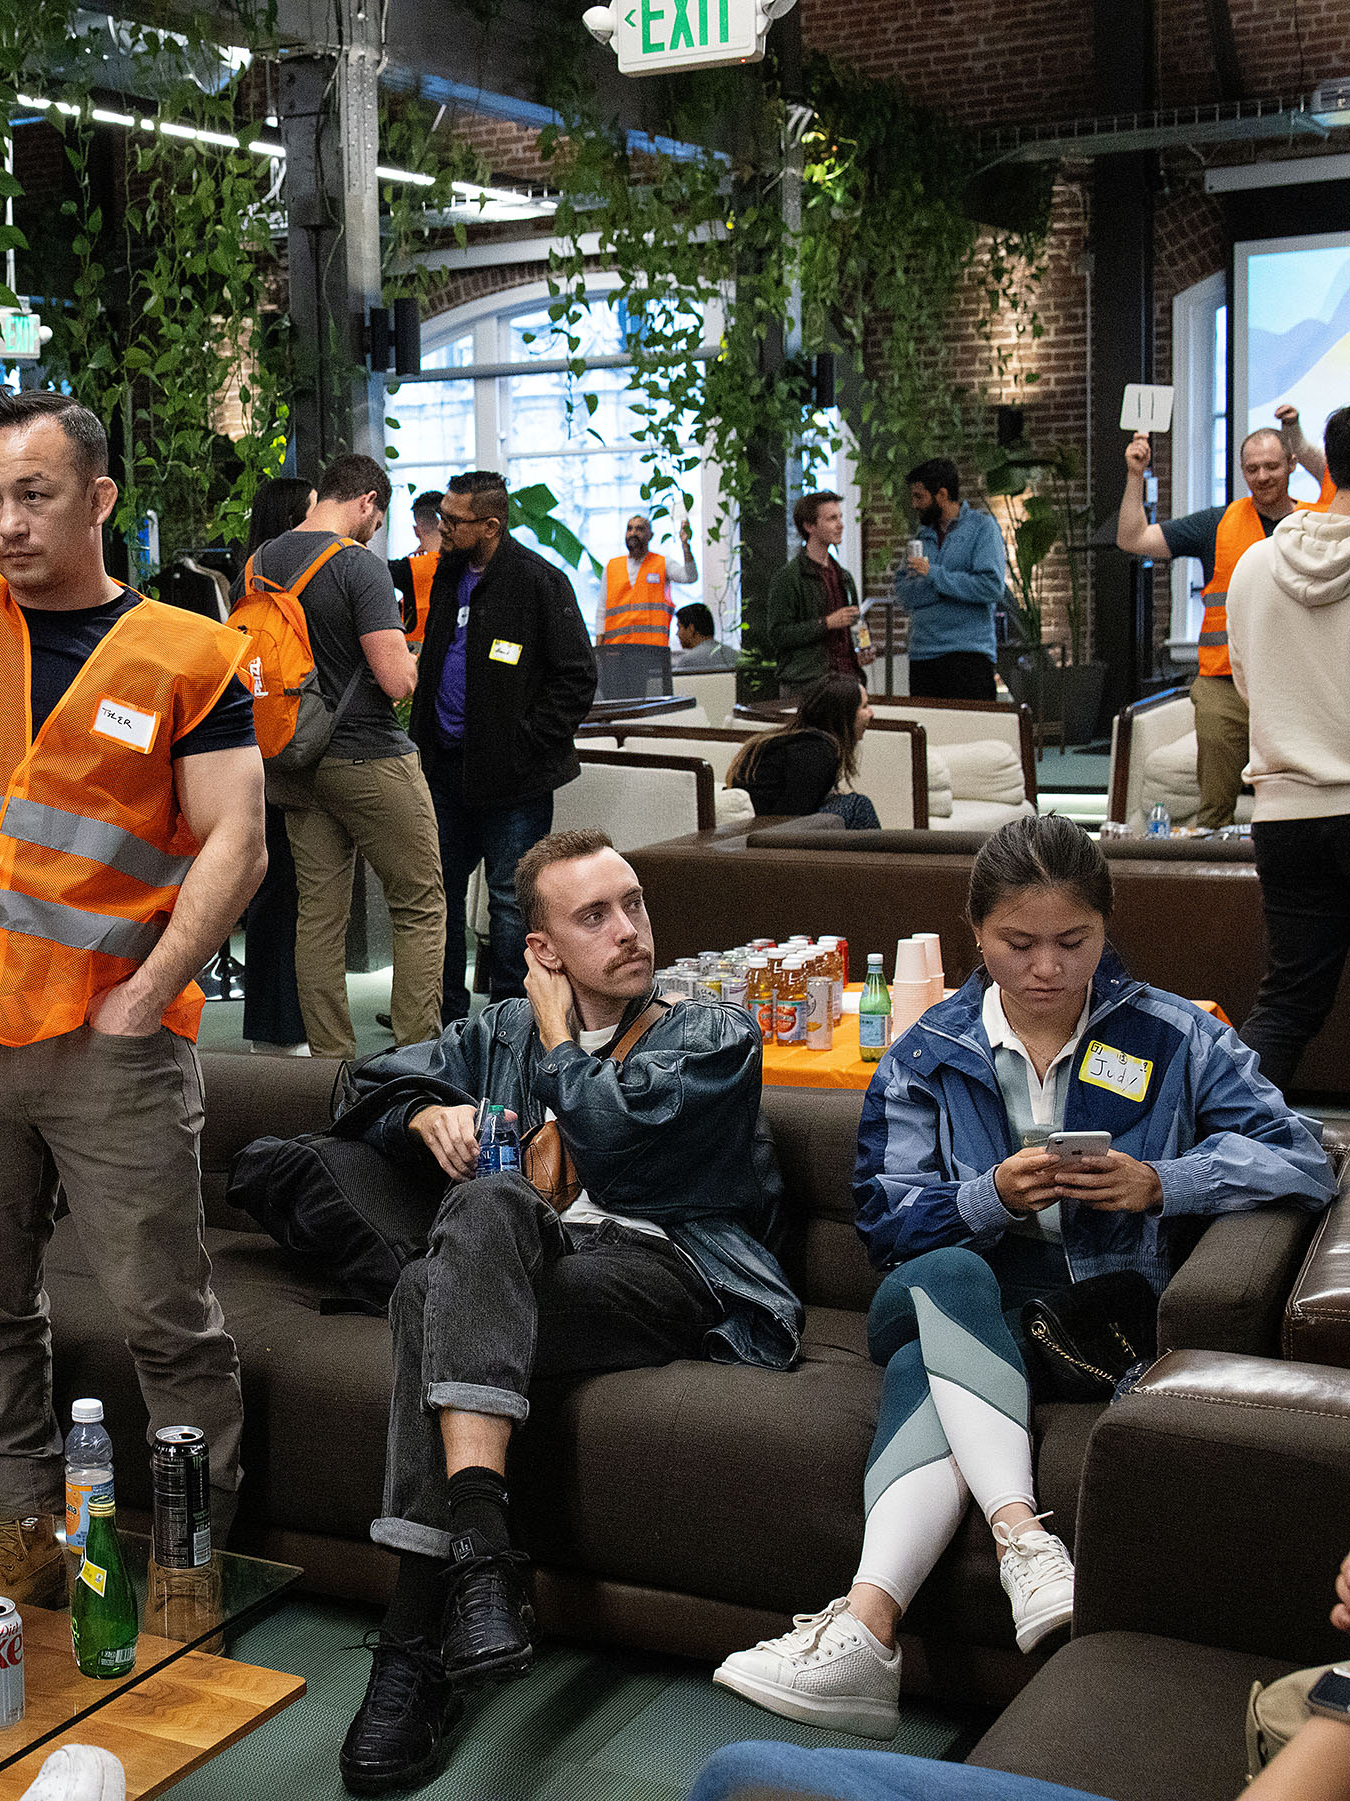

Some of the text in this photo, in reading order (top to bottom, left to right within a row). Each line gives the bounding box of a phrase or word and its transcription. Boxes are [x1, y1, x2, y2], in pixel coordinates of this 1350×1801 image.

[642, 0, 729, 54] EXIT
[6, 316, 34, 352] EXIT
[1137, 391, 1155, 420] 11
[250, 656, 269, 697] PETZL
[102, 707, 132, 730] TYLER
